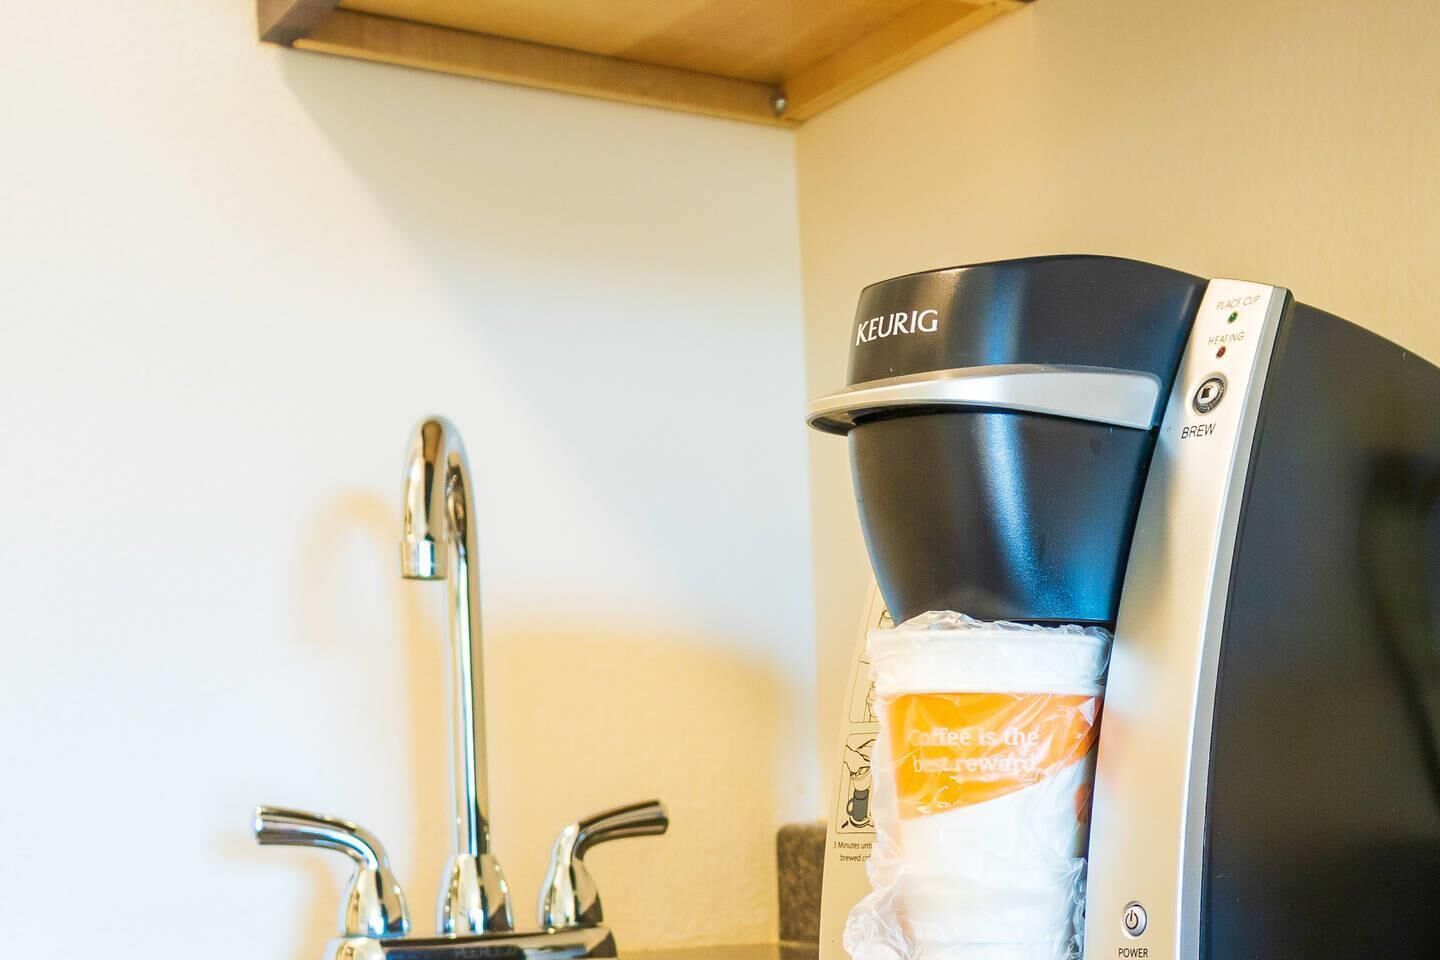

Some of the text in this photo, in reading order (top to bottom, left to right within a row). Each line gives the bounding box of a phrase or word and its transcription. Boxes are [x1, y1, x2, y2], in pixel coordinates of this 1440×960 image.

[1216, 294, 1261, 310] PLACE CUP
[855, 309, 939, 347] KEURIG
[1208, 331, 1245, 345] HEATING
[1181, 422, 1217, 440] BREW
[910, 725, 1040, 747] Coffee is the
[912, 754, 1038, 773] best reward
[838, 841, 860, 850] Minutes
[861, 842, 873, 850] unti
[840, 853, 861, 862] brewed
[1118, 947, 1149, 958] POWER
